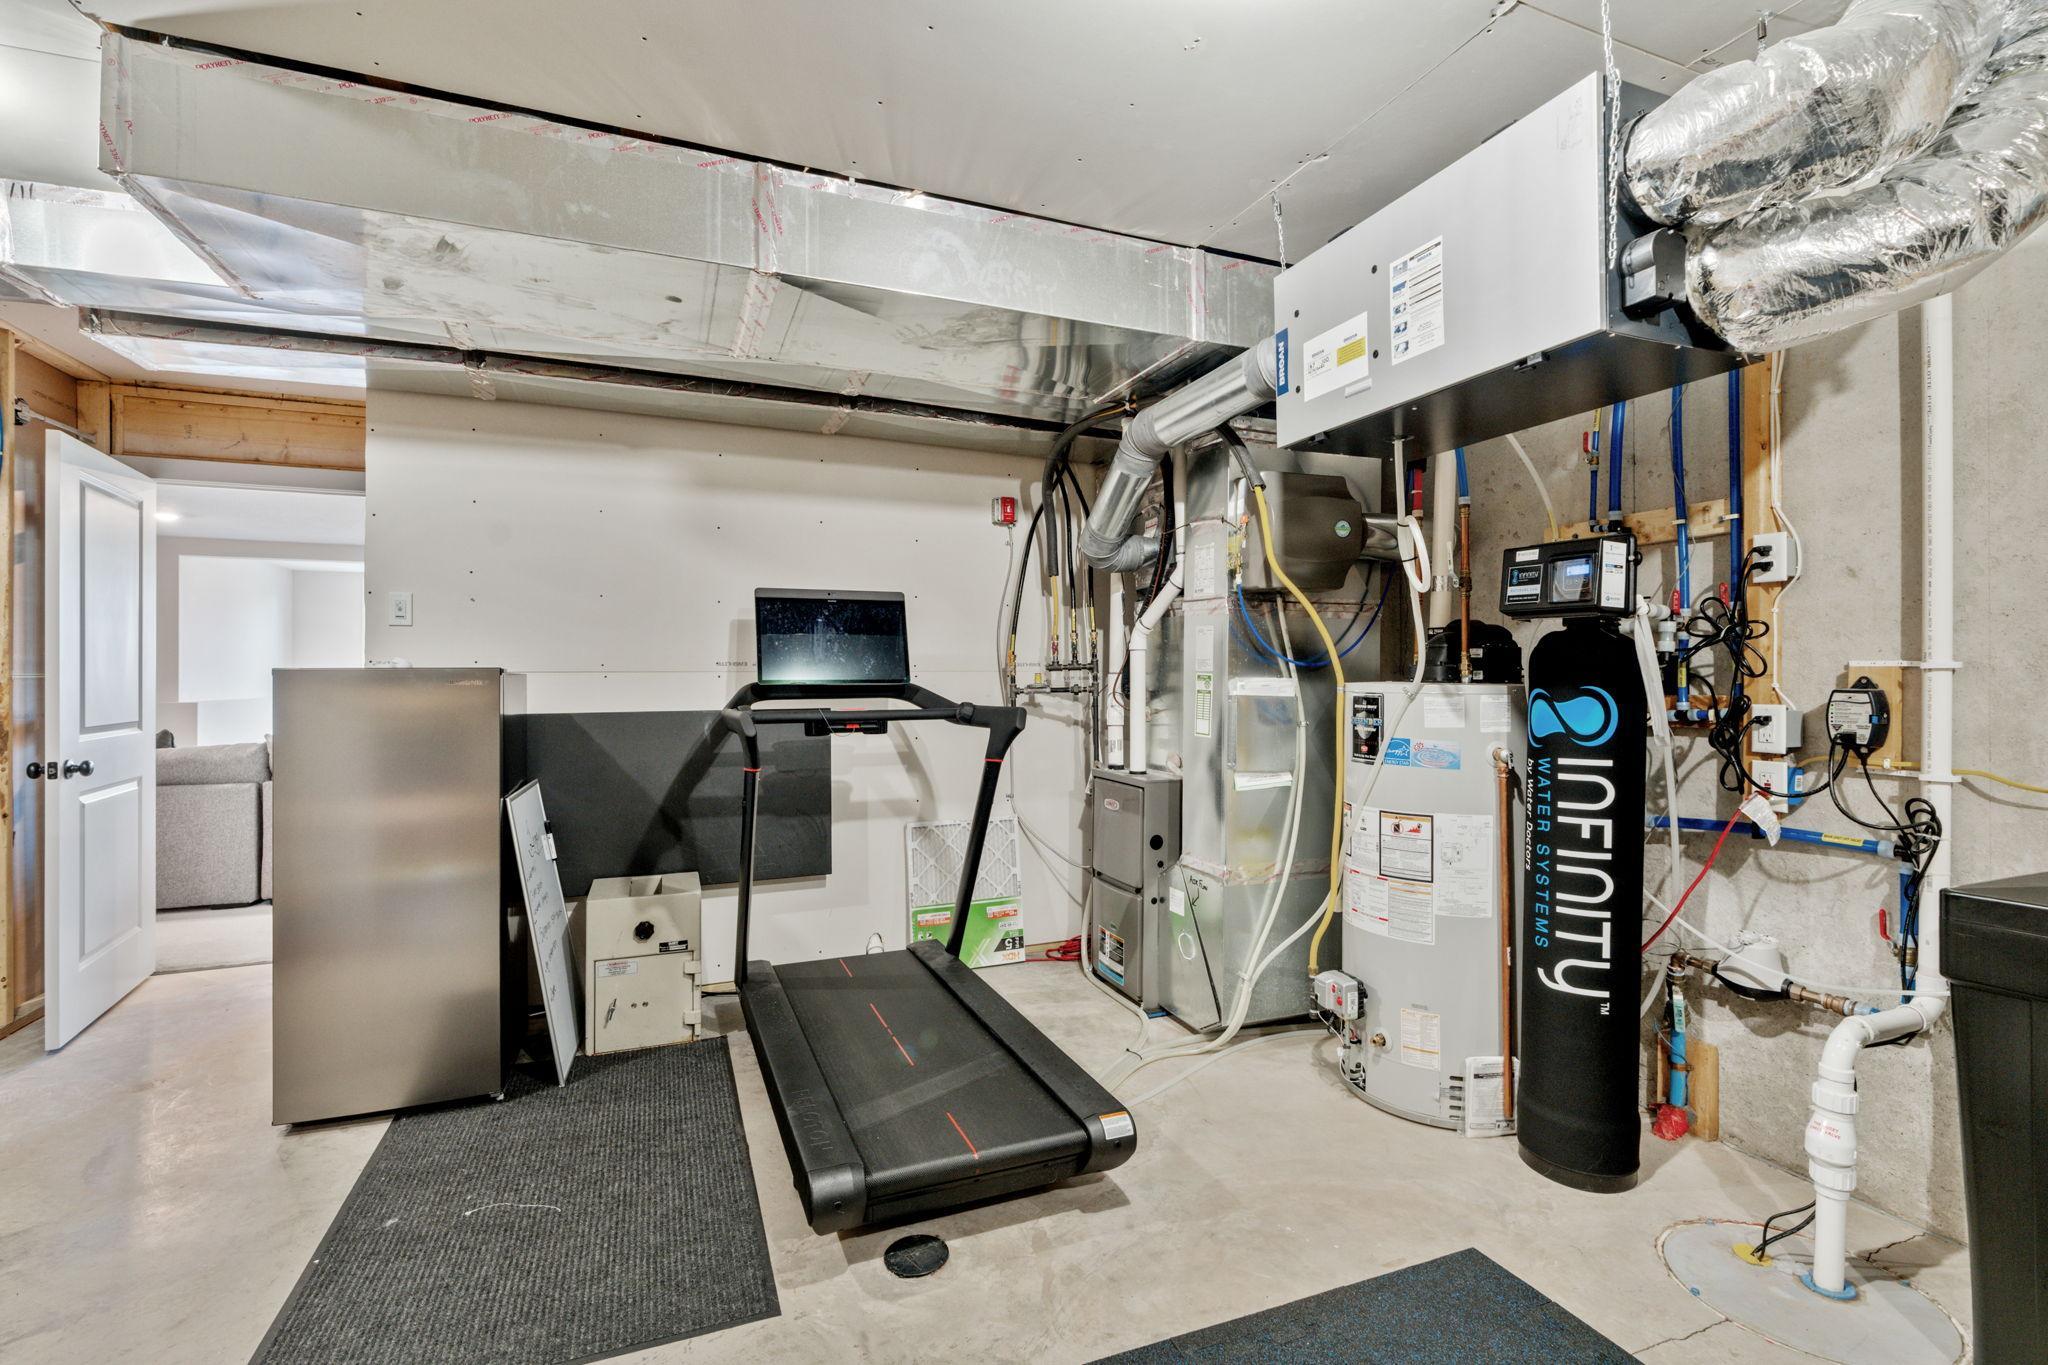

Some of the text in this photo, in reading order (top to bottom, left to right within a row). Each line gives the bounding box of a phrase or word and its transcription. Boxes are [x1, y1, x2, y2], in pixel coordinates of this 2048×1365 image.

[1278, 340, 1286, 386] BROAN
[1526, 778, 1534, 816] Water
[1525, 819, 1533, 871] Doctors
[1534, 757, 1551, 948] WATER SYSTEMS
[1005, 938, 1013, 950] 5
